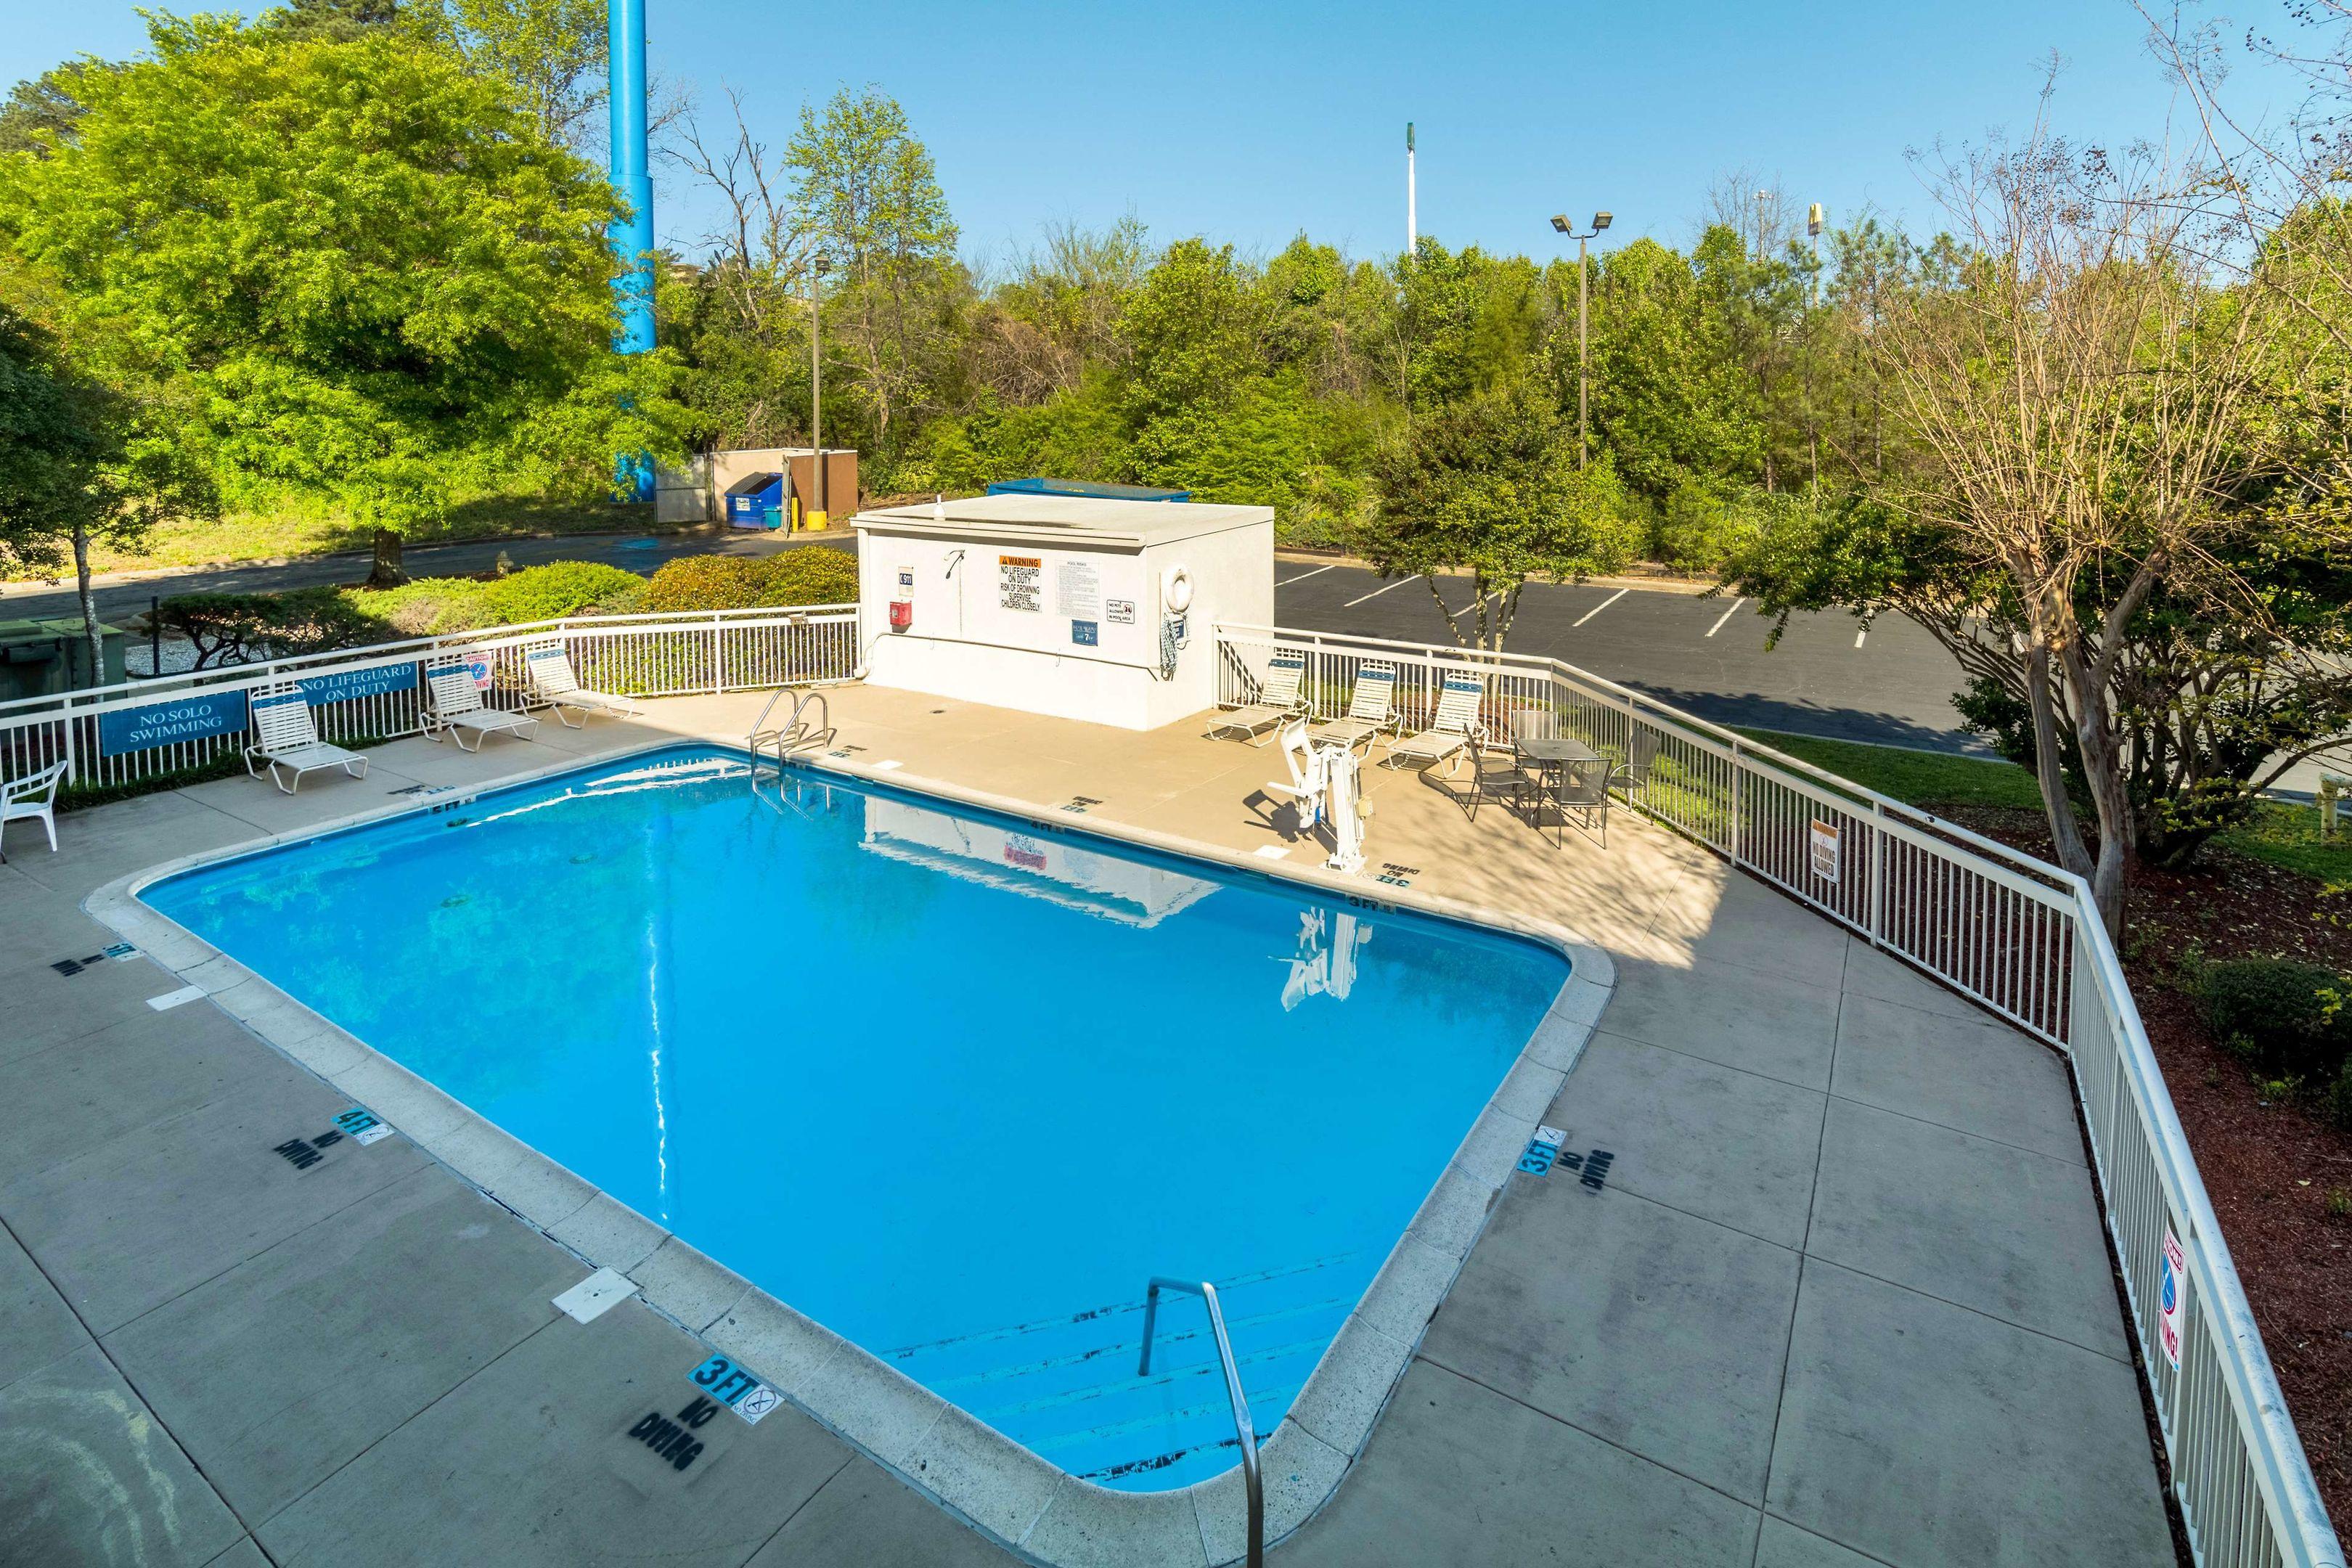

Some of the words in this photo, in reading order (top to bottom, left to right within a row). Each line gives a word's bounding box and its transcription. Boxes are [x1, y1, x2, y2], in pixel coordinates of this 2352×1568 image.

[1008, 557, 1038, 567] WARNING
[1010, 567, 1040, 577] LIFEGUARD
[1008, 574, 1016, 583] ON
[1017, 576, 1031, 584] DUTY
[1009, 592, 1031, 603] SUPERVISE
[1017, 584, 1040, 595] DROWNING
[1002, 599, 1021, 609] CHILDREN
[1021, 602, 1040, 611] CLOSELY
[303, 680, 324, 692] NO
[329, 665, 412, 688] LIFEGUARD
[327, 690, 346, 701] ON
[351, 681, 390, 697] DUTY
[140, 713, 166, 727] NO
[169, 705, 211, 722] SOLO
[130, 716, 222, 743] SWIMMING
[1813, 841, 1818, 855] NO
[1819, 844, 1836, 864] DIVING
[1814, 856, 1834, 876] ALLOWED
[311, 1130, 345, 1148] NO
[273, 1138, 324, 1170] DIVING
[1558, 1151, 1584, 1171] NO
[1580, 1149, 1615, 1191] DIVING
[677, 1396, 719, 1429] NO
[628, 1413, 705, 1471] DIVING
